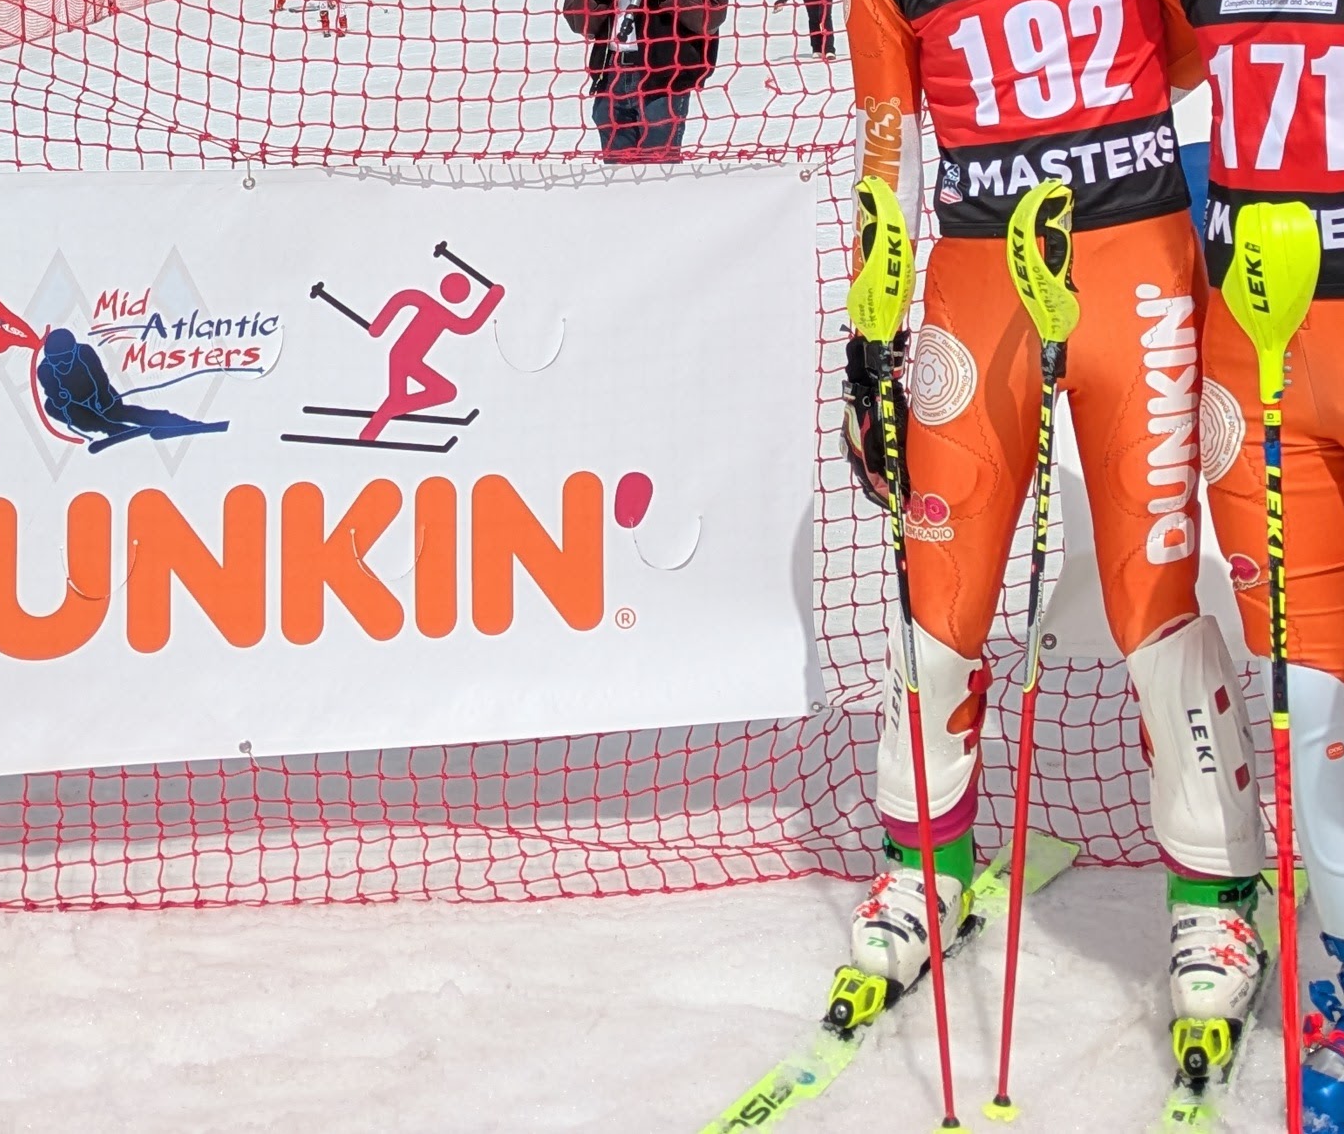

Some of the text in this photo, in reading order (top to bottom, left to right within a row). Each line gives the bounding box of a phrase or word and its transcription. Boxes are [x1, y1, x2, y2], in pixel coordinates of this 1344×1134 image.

[967, 124, 1175, 197] MASTERS
[885, 223, 902, 297] LEKI
[1012, 225, 1036, 301] LEKI
[1244, 241, 1271, 314] LEKI
[93, 287, 151, 320] Mid
[140, 309, 280, 342] Atlantic
[121, 341, 261, 374] Masters
[879, 379, 900, 458] LEKI
[1037, 382, 1053, 465] LEKI
[1135, 283, 1199, 566] DUNKIN'
[1036, 473, 1052, 553] LEKI
[1265, 466, 1284, 559] LEKI
[1186, 708, 1218, 774] LEKI
